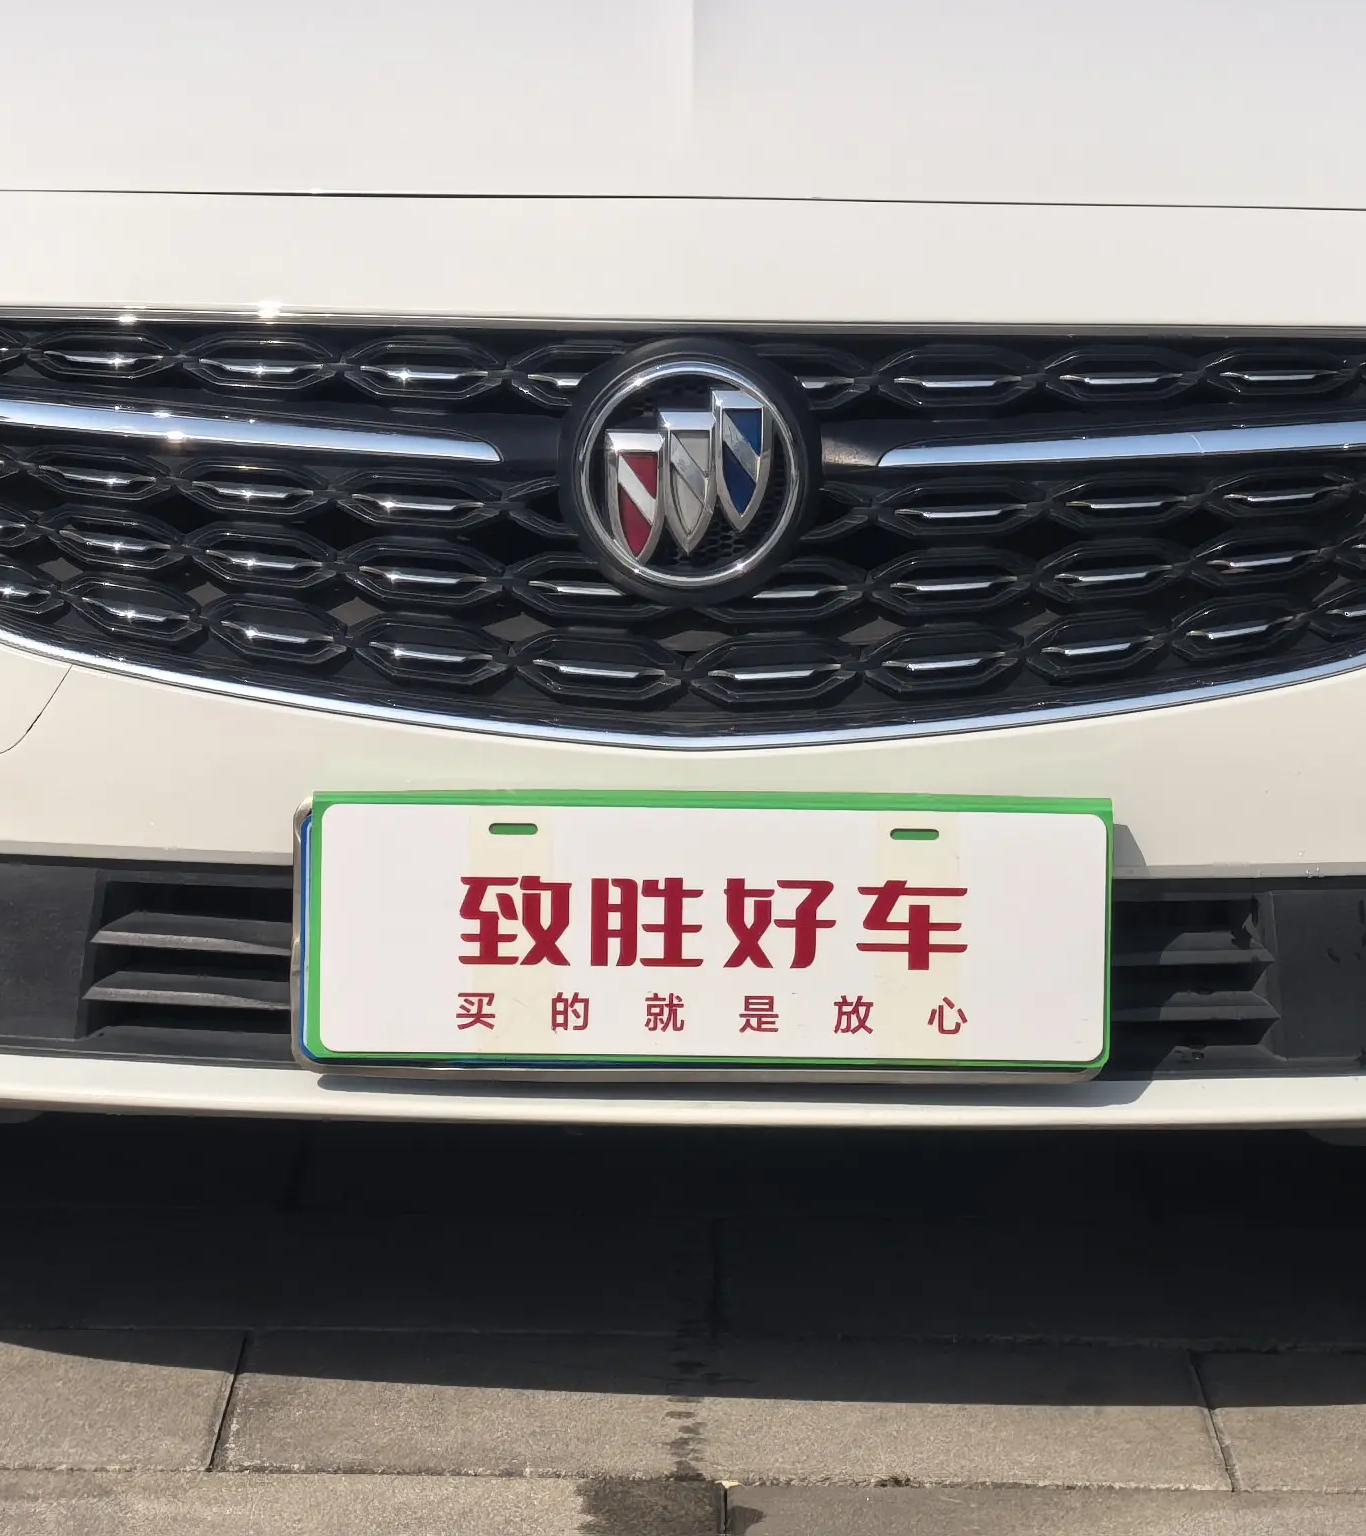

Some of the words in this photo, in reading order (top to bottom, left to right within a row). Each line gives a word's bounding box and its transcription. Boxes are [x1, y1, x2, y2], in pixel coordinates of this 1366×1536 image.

[459, 875, 968, 970] 致胜好车
[456, 992, 968, 1034] 买的就是放心
